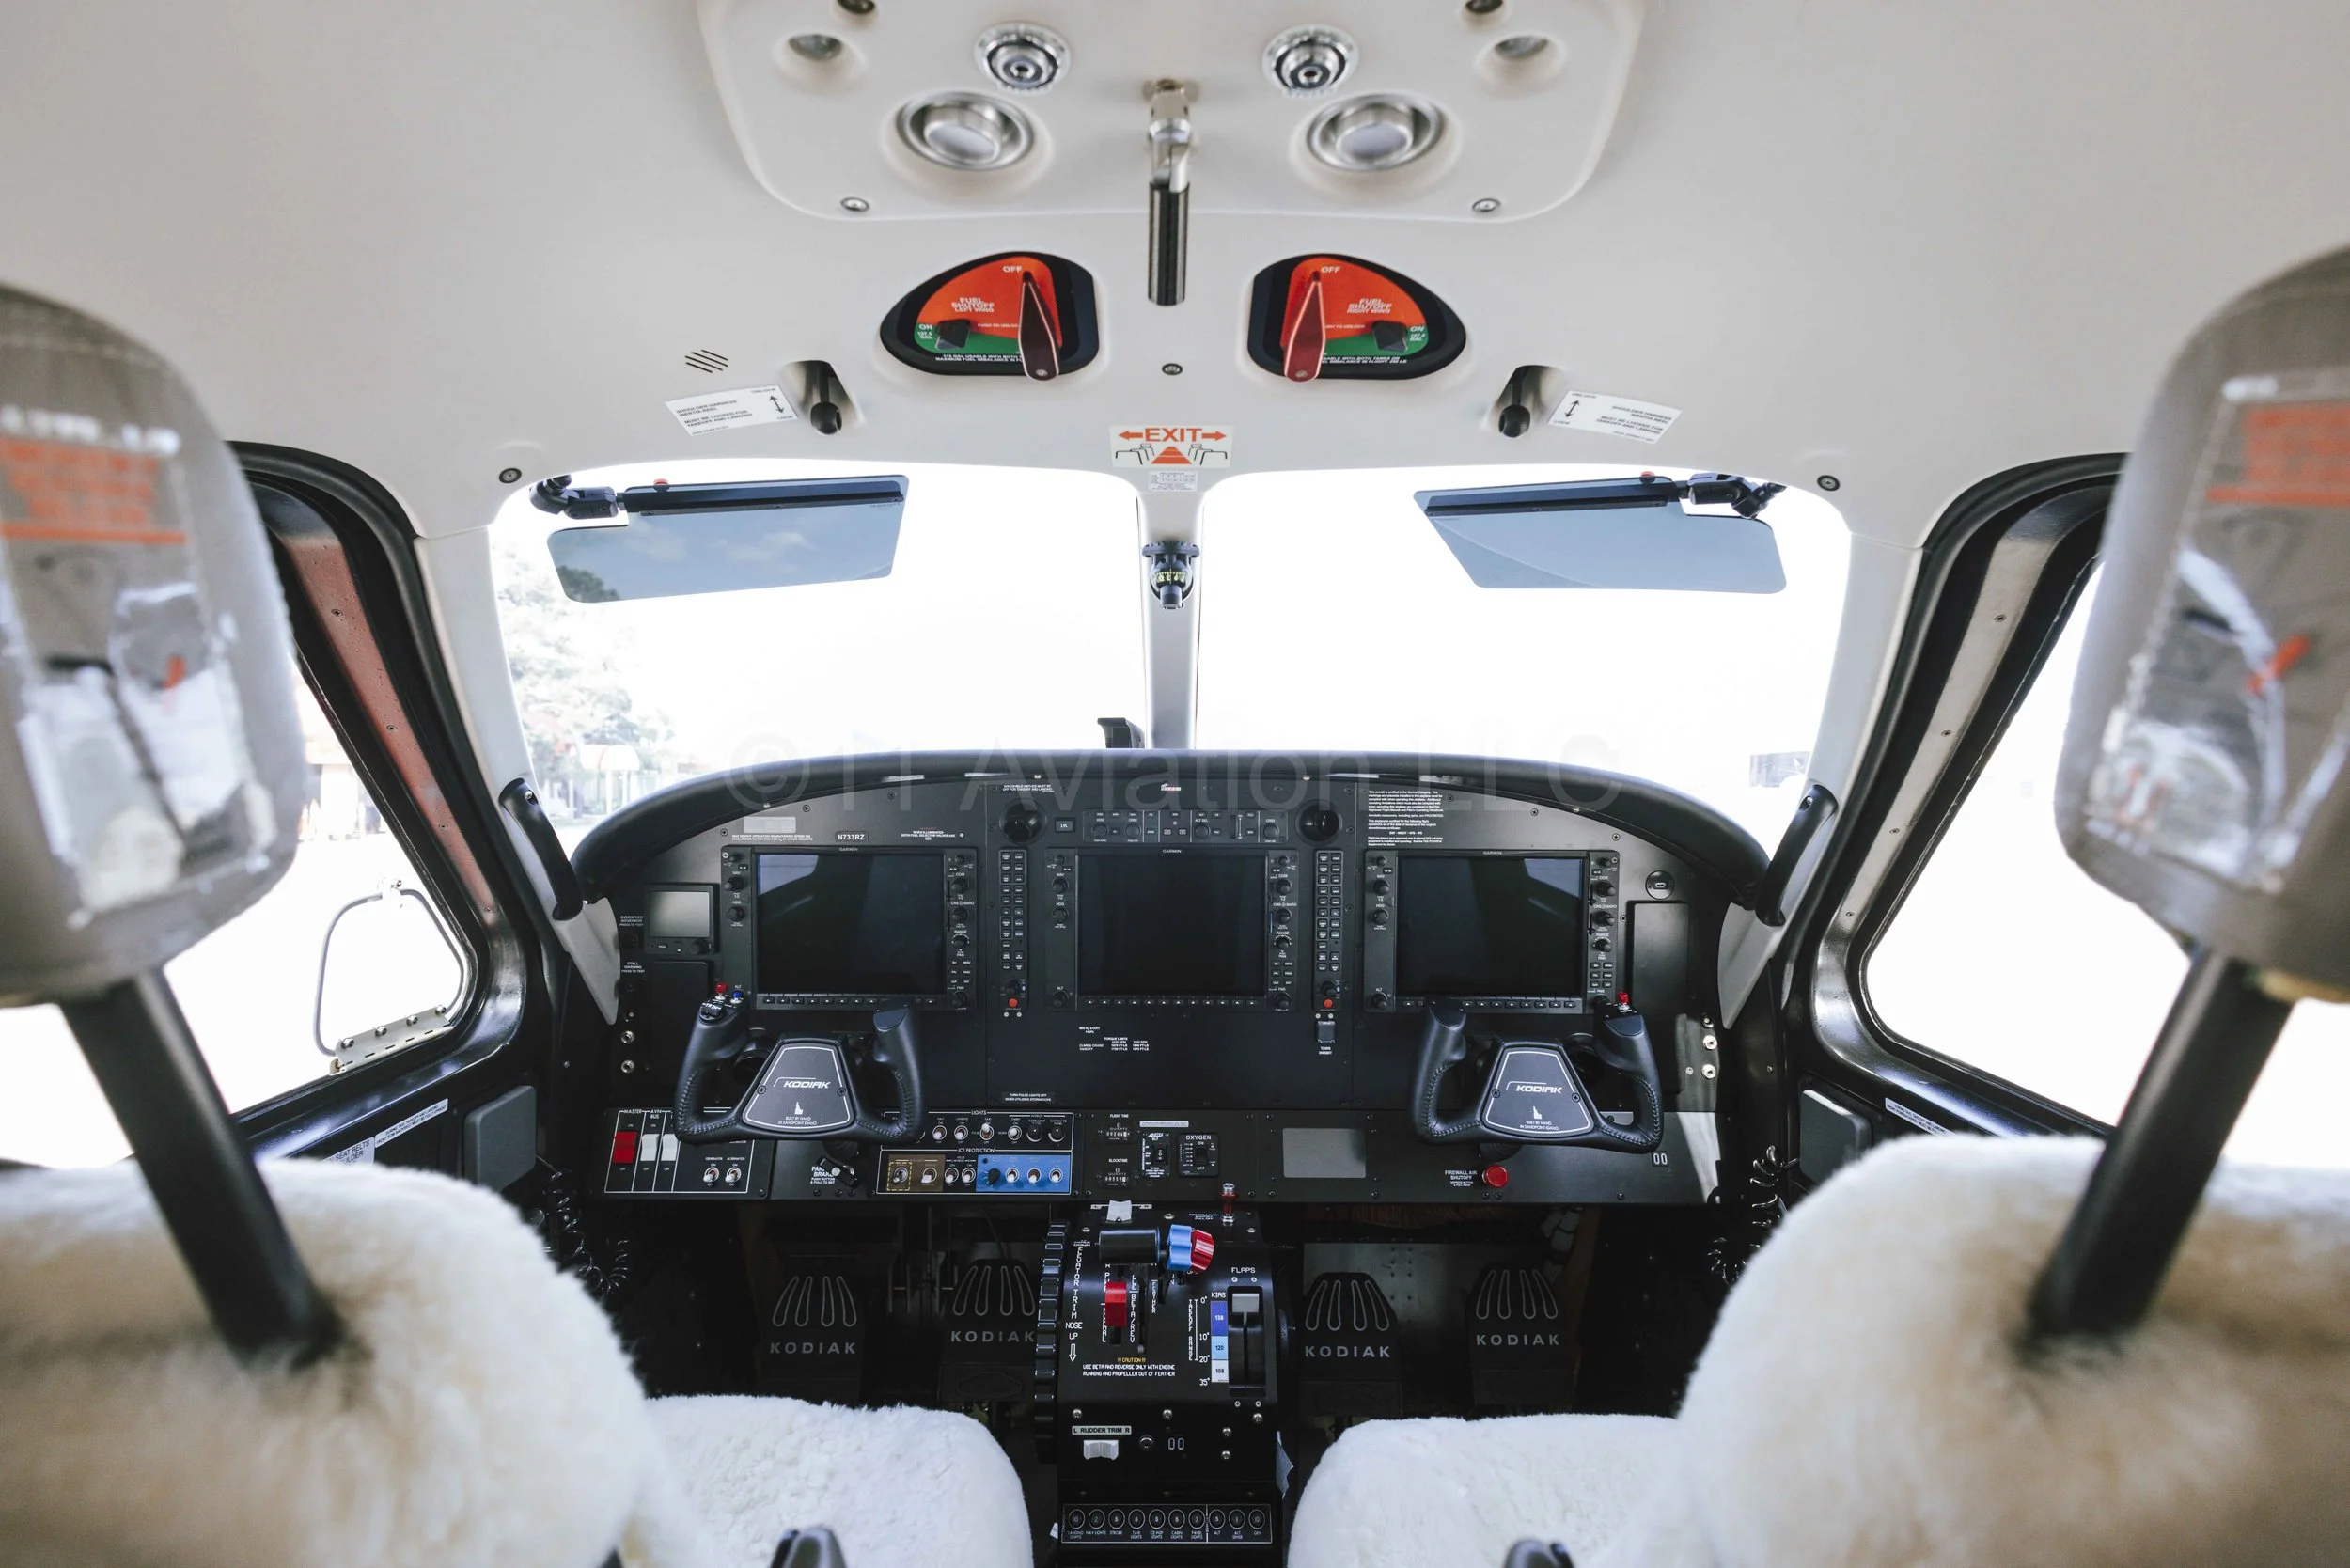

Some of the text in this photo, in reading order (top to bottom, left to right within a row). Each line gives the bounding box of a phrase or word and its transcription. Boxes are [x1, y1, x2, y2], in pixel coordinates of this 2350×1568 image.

[1145, 428, 1202, 442] EXIT
[783, 1080, 832, 1089] KODIAK
[1515, 1085, 1564, 1094] KODIAK
[335, 1139, 370, 1160] SEAT BELTS
[951, 1331, 1034, 1342] KODIAK
[1477, 1334, 1559, 1346] KODIAK
[770, 1341, 856, 1355] KODIAK
[1305, 1345, 1390, 1357] KODIAK
